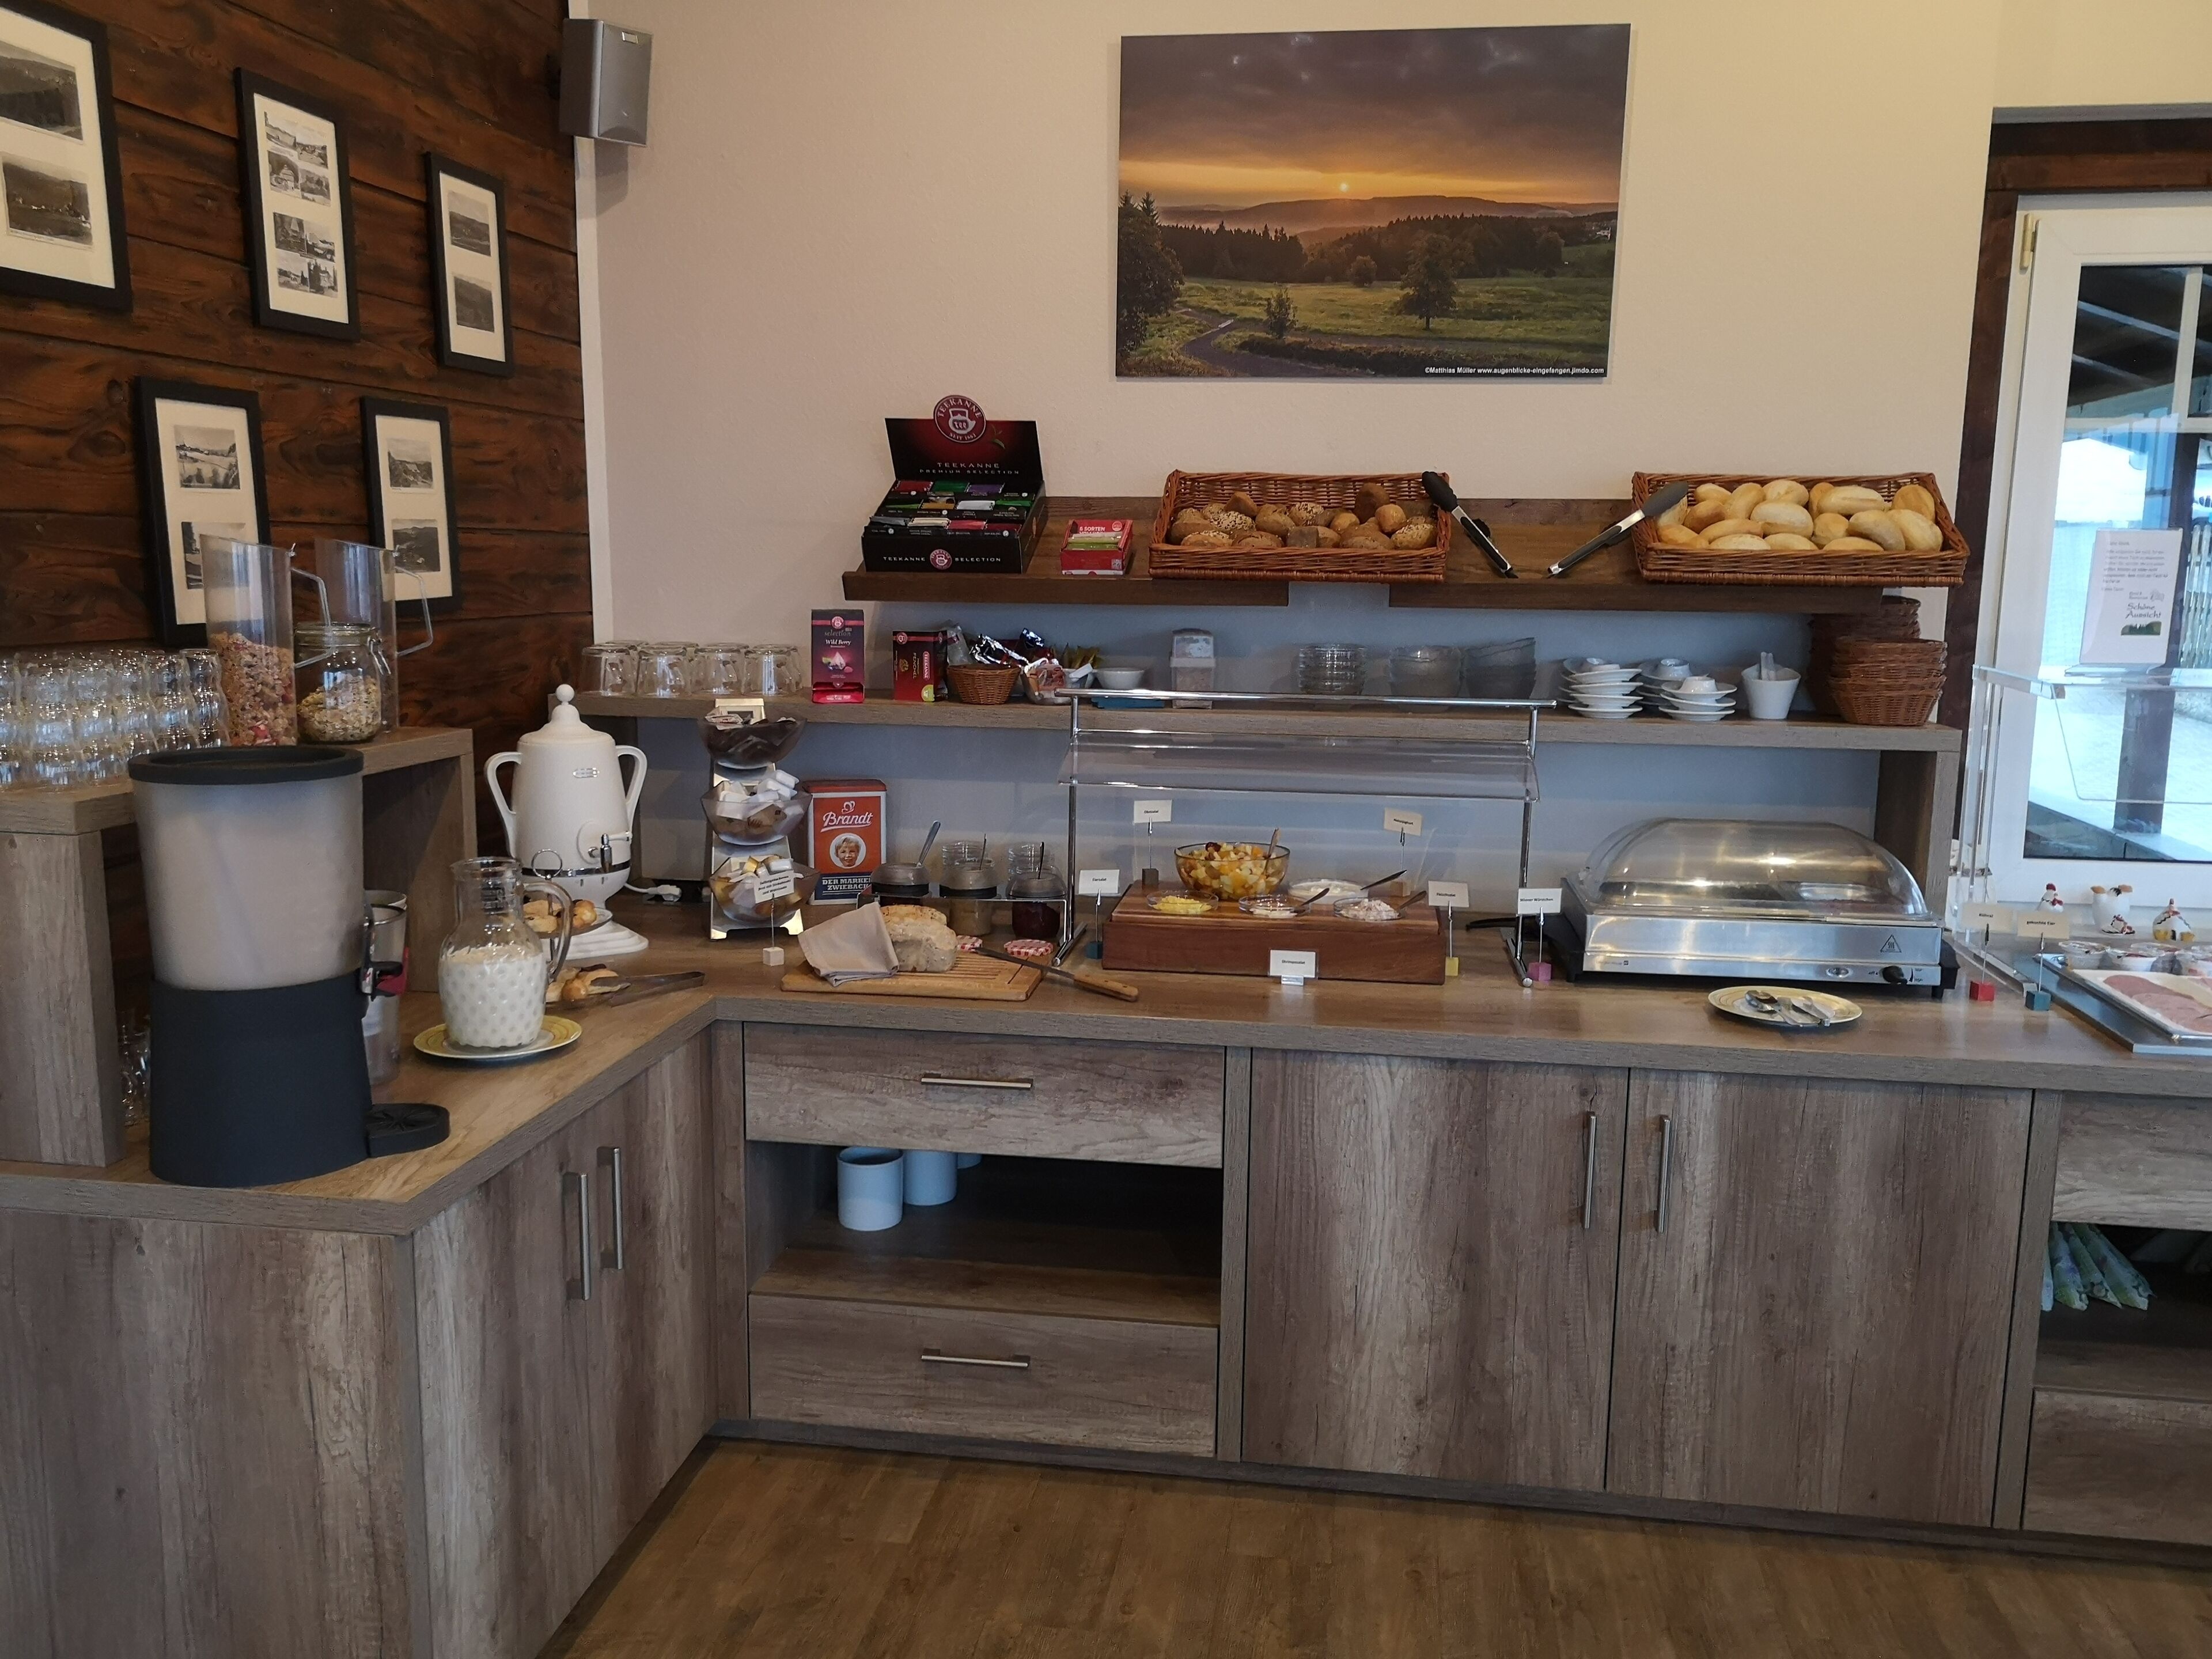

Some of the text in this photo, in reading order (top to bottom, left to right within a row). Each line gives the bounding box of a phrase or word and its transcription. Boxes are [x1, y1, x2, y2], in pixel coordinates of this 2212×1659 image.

[937, 399, 982, 419] TEEKANNE
[954, 421, 967, 429] tee
[949, 432, 963, 441] SEIT
[2127, 602, 2156, 611] Schöne
[824, 628, 851, 637] selection
[822, 811, 874, 827] Brandt
